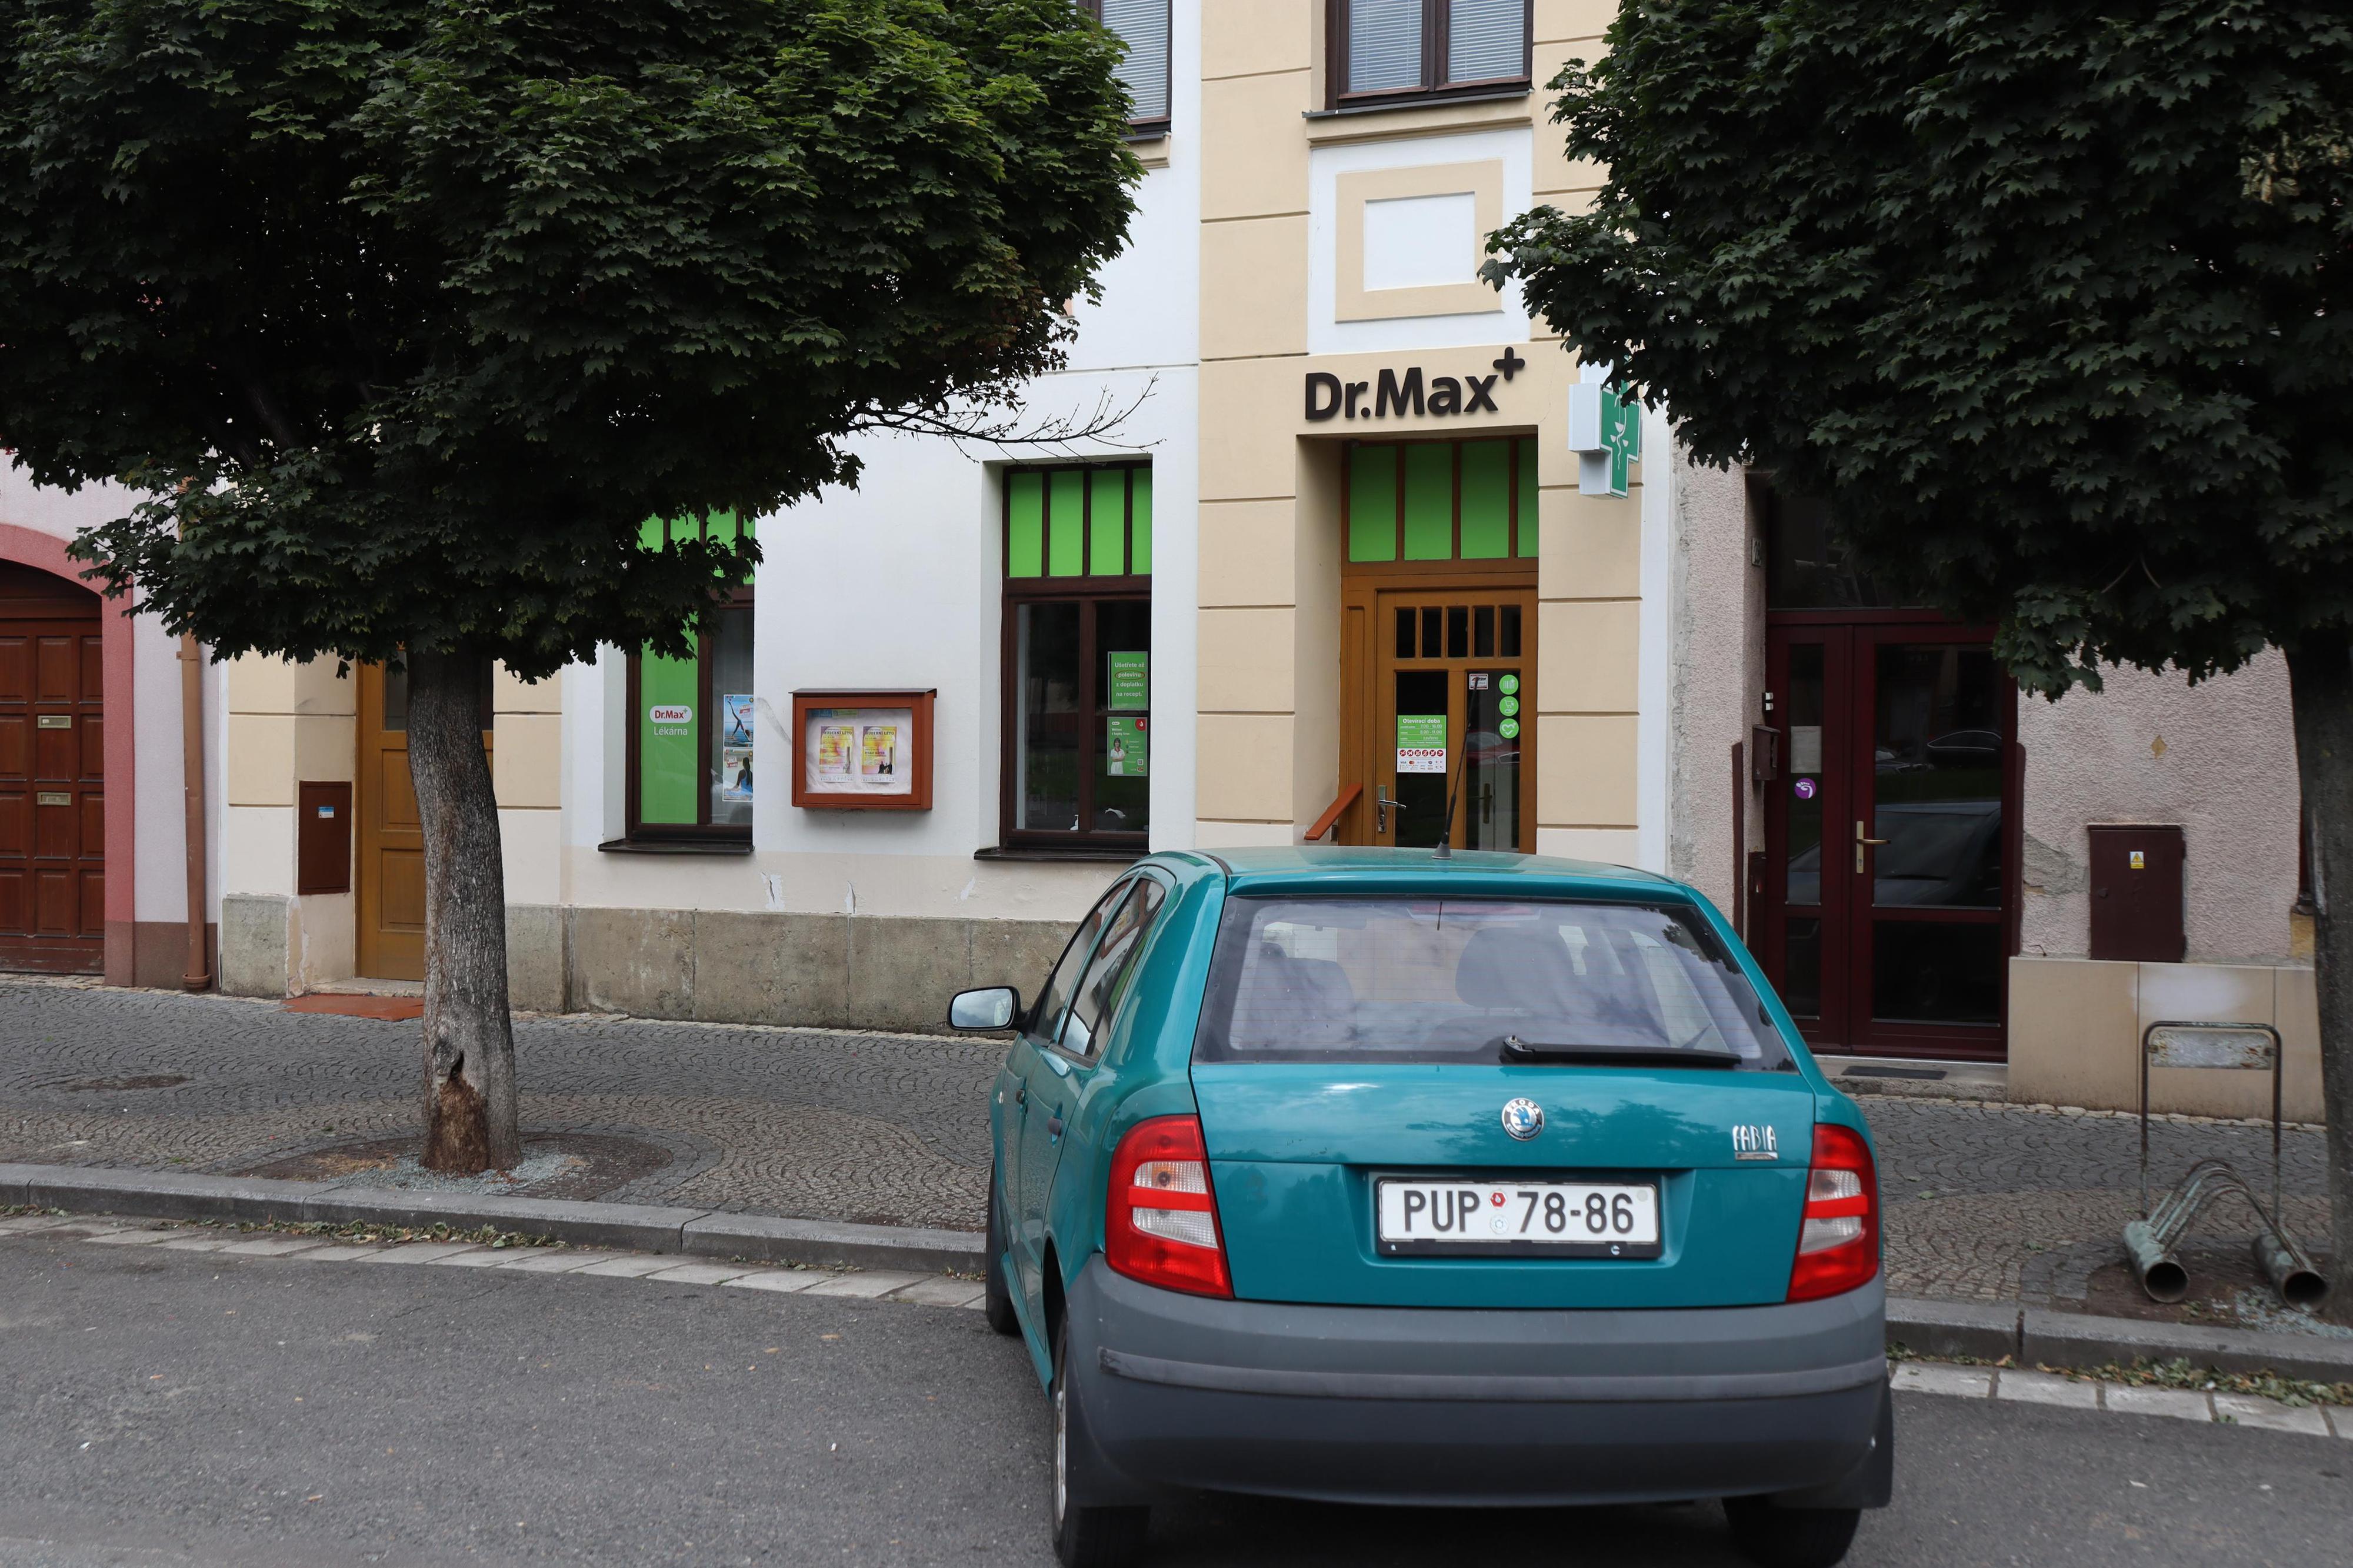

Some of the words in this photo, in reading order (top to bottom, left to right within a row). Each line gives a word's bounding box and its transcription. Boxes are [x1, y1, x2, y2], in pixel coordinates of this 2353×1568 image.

[654, 726, 688, 735] Lékárna
[1732, 1125, 1777, 1151] FABIA
[1404, 1190, 1480, 1233] PUP
[1517, 1191, 1634, 1234] 78-86
